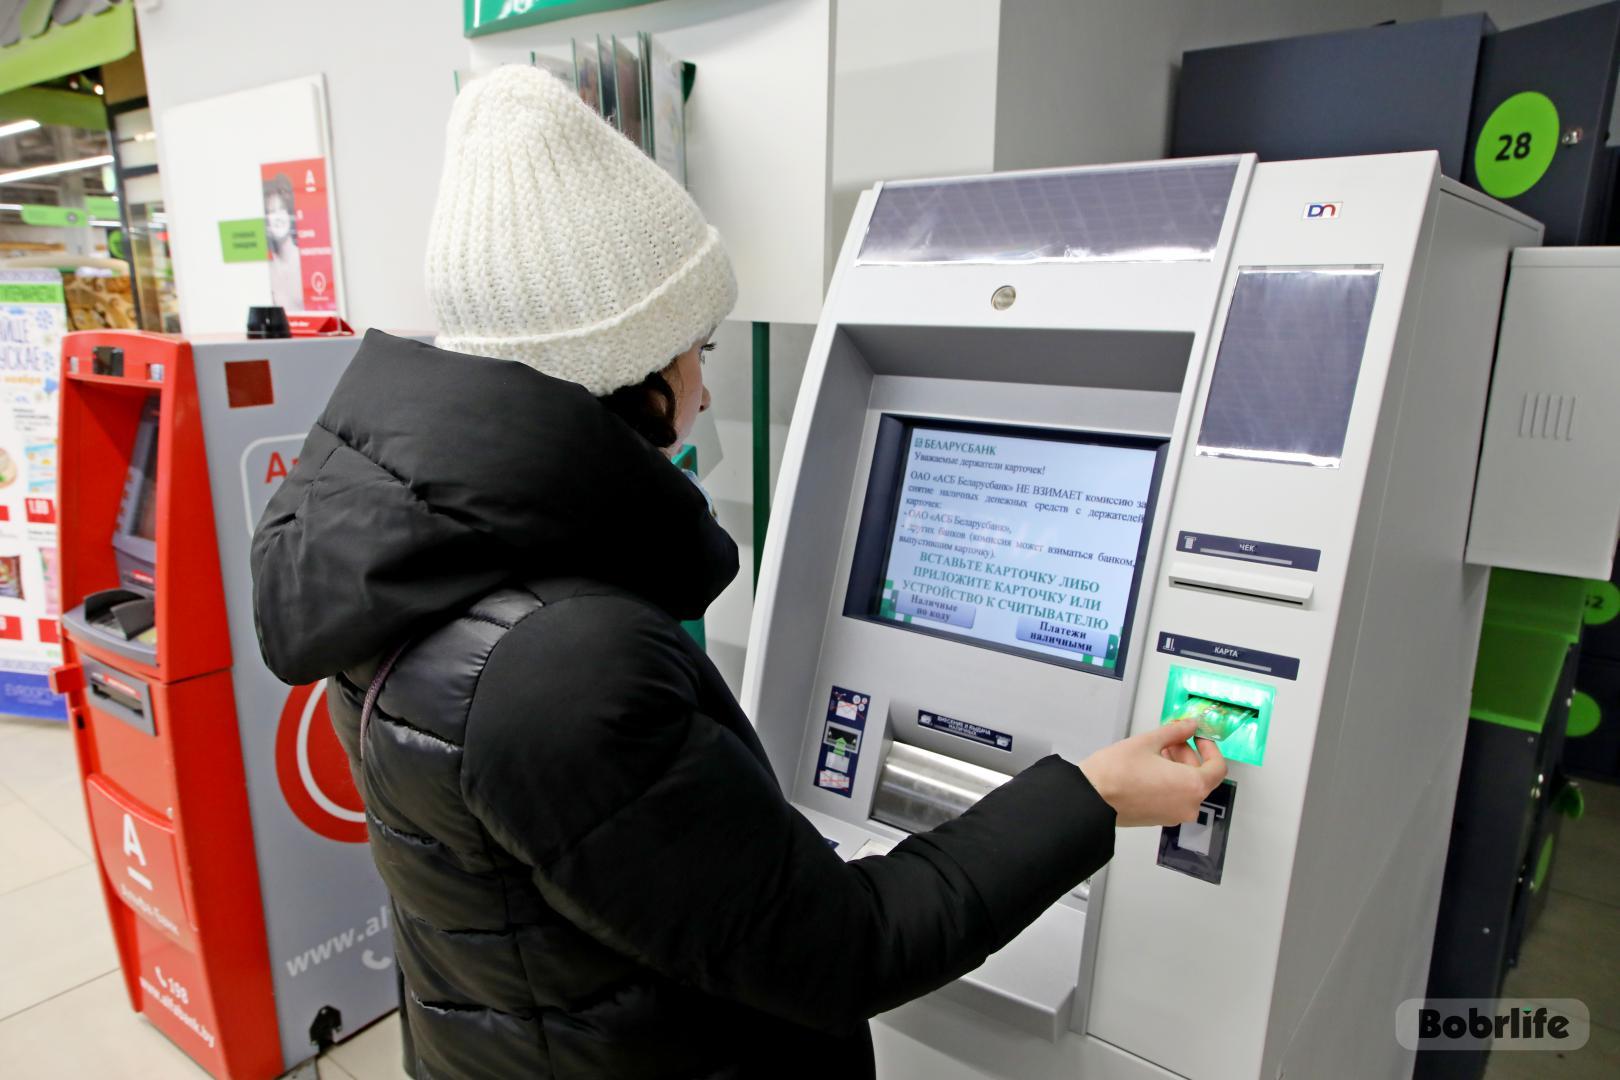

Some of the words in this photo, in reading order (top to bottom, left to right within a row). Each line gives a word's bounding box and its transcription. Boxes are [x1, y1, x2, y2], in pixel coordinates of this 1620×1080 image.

[1495, 132, 1532, 161] 28
[924, 439, 997, 456] БЕЛАРУСБАНК
[914, 452, 959, 465] Уважаемые
[959, 458, 1003, 471] держатели
[1004, 463, 1046, 475] карточек!
[910, 470, 931, 481] ОАО
[1016, 483, 1030, 495] НЕ
[1032, 485, 1083, 501] ВЗИМАЕТ
[1085, 494, 1134, 507] комиссию
[984, 494, 1028, 508] денежных
[1034, 501, 1069, 513] средств
[1087, 509, 1145, 524] держателей
[1047, 546, 1094, 560] взиматься
[1239, 543, 1256, 552] ЧЕК
[920, 551, 983, 573] ВСТАВЬТЕ
[985, 563, 1057, 585] КАРТОЧКУ
[1058, 576, 1100, 593] ЛИБО
[913, 566, 991, 590] ПРИЛОЖИТЕ
[994, 582, 1067, 604] КАРТОЧКУ
[1069, 595, 1102, 612] ИЛИ
[902, 580, 983, 605] УСТРОЙСТВО
[986, 596, 996, 608] К
[997, 598, 1109, 631] СЧИТЫВАТЕЛЮ
[911, 594, 958, 612] Наличные
[1040, 621, 1087, 639] Платежи
[1030, 632, 1093, 652] наличными
[1214, 646, 1239, 658] КАРТА
[286, 905, 388, 977] www.al
